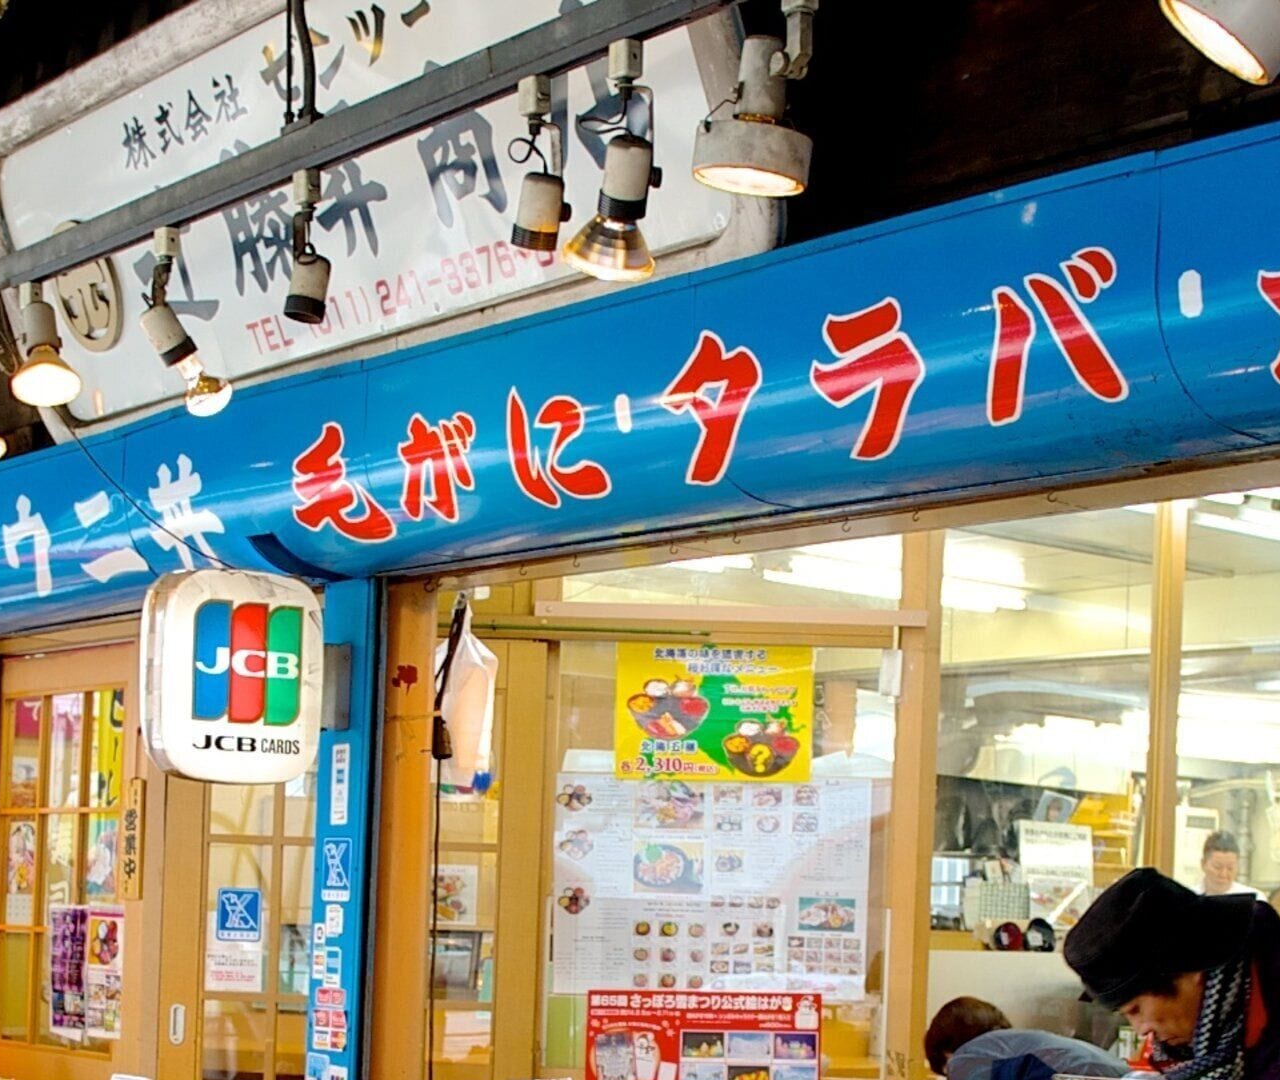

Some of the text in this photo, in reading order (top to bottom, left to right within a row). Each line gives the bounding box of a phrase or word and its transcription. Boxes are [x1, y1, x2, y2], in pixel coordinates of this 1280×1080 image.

[246, 314, 295, 354] TEL
[195, 647, 299, 680] JCB
[192, 734, 300, 756] JCB CARDS
[123, 808, 138, 879] 営業中
